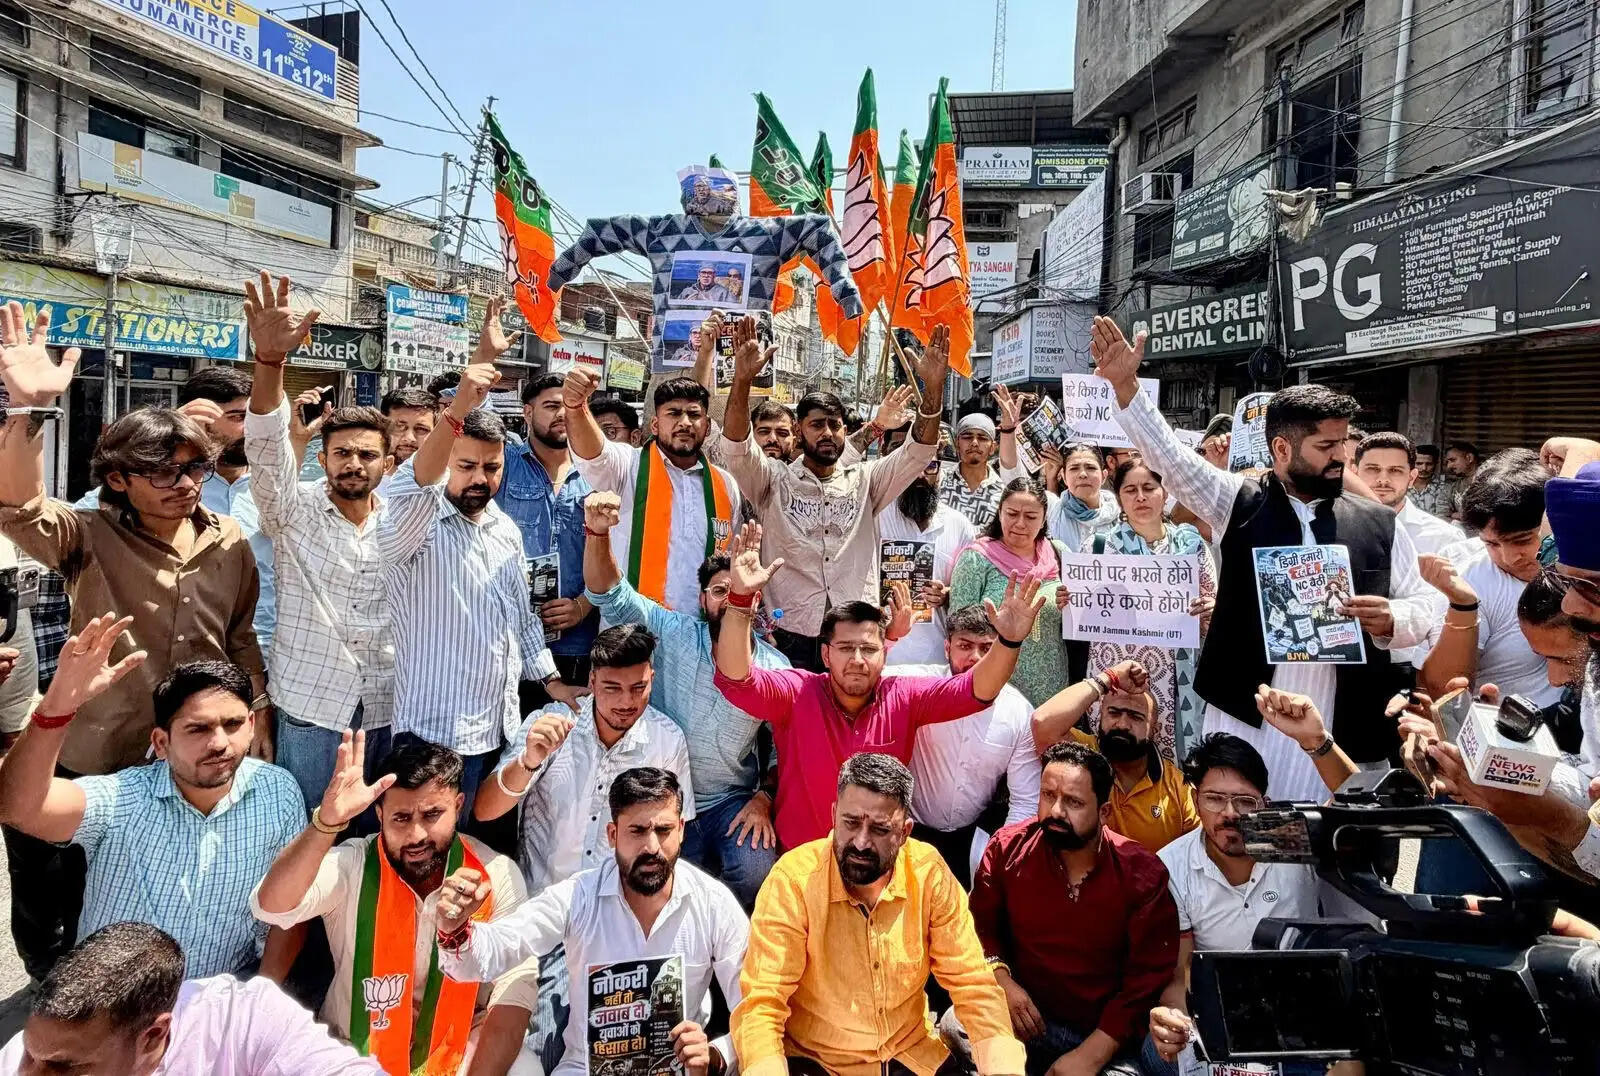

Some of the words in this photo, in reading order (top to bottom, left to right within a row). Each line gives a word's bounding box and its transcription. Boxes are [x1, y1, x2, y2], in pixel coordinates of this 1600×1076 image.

[120, 0, 253, 60] UMANITIES
[965, 159, 1030, 168] PRATHAM
[1353, 201, 1425, 233] HIMALAYAN
[1428, 184, 1477, 208] LIVING
[1404, 228, 1424, 239] Fully
[1426, 213, 1468, 232] Furnished
[1470, 201, 1513, 220] Spacious
[1515, 195, 1531, 206] AC
[1533, 186, 1571, 201] Rooms
[1404, 239, 1440, 254] Attached
[1441, 227, 1485, 245] Bathroom
[1486, 221, 1505, 232] and
[1506, 210, 1546, 227] Almirah
[1405, 237, 1419, 246] 100
[1420, 230, 1442, 242] Mbps
[1444, 224, 1464, 237] High
[1466, 214, 1495, 229] Speed
[1497, 205, 1523, 221] FTTH
[1405, 245, 1450, 262] Homemade
[1451, 238, 1477, 250] Fresh
[1479, 230, 1503, 244] Food
[1405, 261, 1418, 270] RO
[1419, 253, 1451, 267] Purified
[1453, 244, 1491, 259] Drinking
[1492, 236, 1521, 248] Water
[1406, 270, 1414, 278] 24
[1416, 266, 1436, 276] Hour
[1438, 261, 1453, 271] Hot
[1454, 255, 1480, 266] Water
[1482, 251, 1489, 260] &
[1491, 245, 1522, 258] Power
[1524, 234, 1561, 250] Supply
[983, 261, 1013, 273] SANGAM
[1405, 276, 1430, 286] Indoor
[1454, 265, 1477, 275] Table
[1479, 257, 1511, 270] Tennis,
[1513, 248, 1550, 262] Carrom
[1290, 243, 1383, 332] PG
[1406, 284, 1432, 294] CCTVs
[1433, 280, 1447, 288] For
[1449, 272, 1484, 285] Security
[1406, 294, 1423, 302] First
[1425, 290, 1438, 299] Aid
[1440, 284, 1468, 295] Facility
[408, 287, 451, 305] KANIKA
[1406, 300, 1436, 310] Parking
[1436, 294, 1462, 305] Space
[1037, 311, 1063, 319] SCHOOL
[1518, 302, 1591, 319] himalayanliving_pg
[1001, 322, 1020, 343] ASIA
[1036, 330, 1056, 338] BOOKS
[1358, 327, 1387, 337] Exchange
[1462, 310, 1488, 319] Jammu
[296, 340, 359, 361] ARKER
[1034, 346, 1065, 354] STATIONERY
[1151, 329, 1217, 353] DENTAL
[1034, 365, 1055, 375] BOOKS
[1078, 380, 1099, 399] किए
[1100, 382, 1110, 400] थे
[1075, 403, 1093, 420] करो
[1095, 406, 1111, 422] NC
[1101, 433, 1127, 441] Kashmir
[1279, 552, 1299, 569] डिग्री
[1300, 548, 1324, 565] हमारी
[1066, 559, 1103, 581] खाली
[1107, 566, 1127, 583] पद
[1131, 560, 1163, 584] भरने
[1167, 560, 1193, 585] होंगे
[1295, 580, 1308, 591] NC
[1069, 586, 1094, 610] वादे
[1097, 587, 1116, 618] पूरे
[1119, 589, 1154, 612] करने
[1158, 590, 1190, 614] होंगे!
[1078, 624, 1101, 634] BJYM
[1102, 625, 1130, 636] Jammu
[1132, 628, 1164, 638] Kashmir
[1166, 630, 1182, 640] (UT)
[1287, 652, 1310, 660] BJYM
[1490, 759, 1536, 773] NEWS
[592, 964, 649, 995] नौकरी
[603, 991, 622, 1006] नहीं
[623, 989, 635, 1004] तो
[662, 993, 673, 1004] NC
[595, 1006, 630, 1025] जवाब
[632, 1003, 648, 1021] दो,
[599, 1022, 630, 1043] युवाओं
[630, 1021, 641, 1035] को
[593, 1039, 629, 1055] हिसाब
